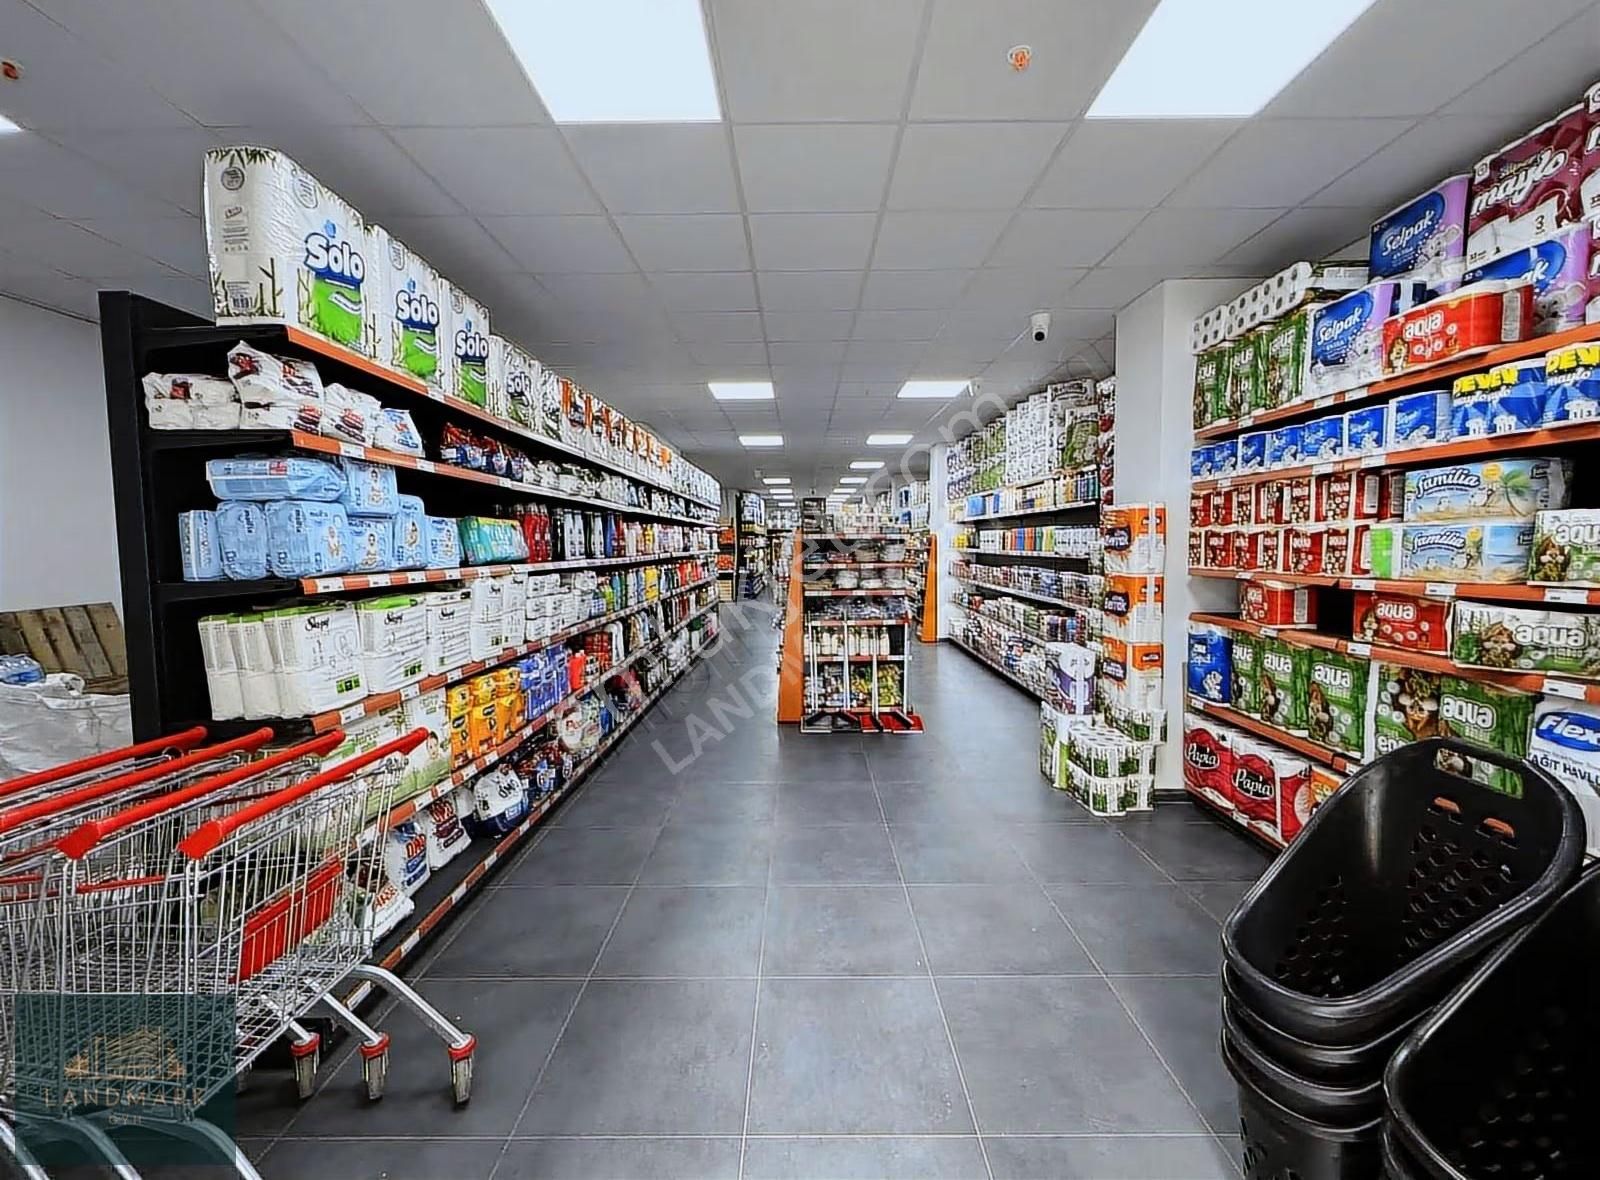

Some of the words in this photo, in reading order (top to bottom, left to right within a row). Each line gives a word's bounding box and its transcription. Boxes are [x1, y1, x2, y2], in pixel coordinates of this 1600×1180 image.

[1382, 209, 1435, 256] Selpak
[1535, 214, 1545, 231] 3
[304, 232, 365, 283] Solo
[396, 290, 440, 326] Solo
[1317, 306, 1363, 346] Selpak
[1403, 310, 1445, 342] aqua
[455, 330, 489, 360] Solo
[1416, 467, 1481, 499] familia
[1413, 530, 1466, 554] familia
[1556, 524, 1600, 545] aqu
[1376, 601, 1415, 620] aqua
[1515, 625, 1587, 648] aqua
[1263, 653, 1293, 674] aqua
[1313, 663, 1352, 688] aqua
[1441, 696, 1495, 730] aqua
[1539, 714, 1600, 746] Flex
[1187, 743, 1217, 766] Papia
[1530, 753, 1559, 770] AĞIT
[1236, 768, 1272, 796] Papia
